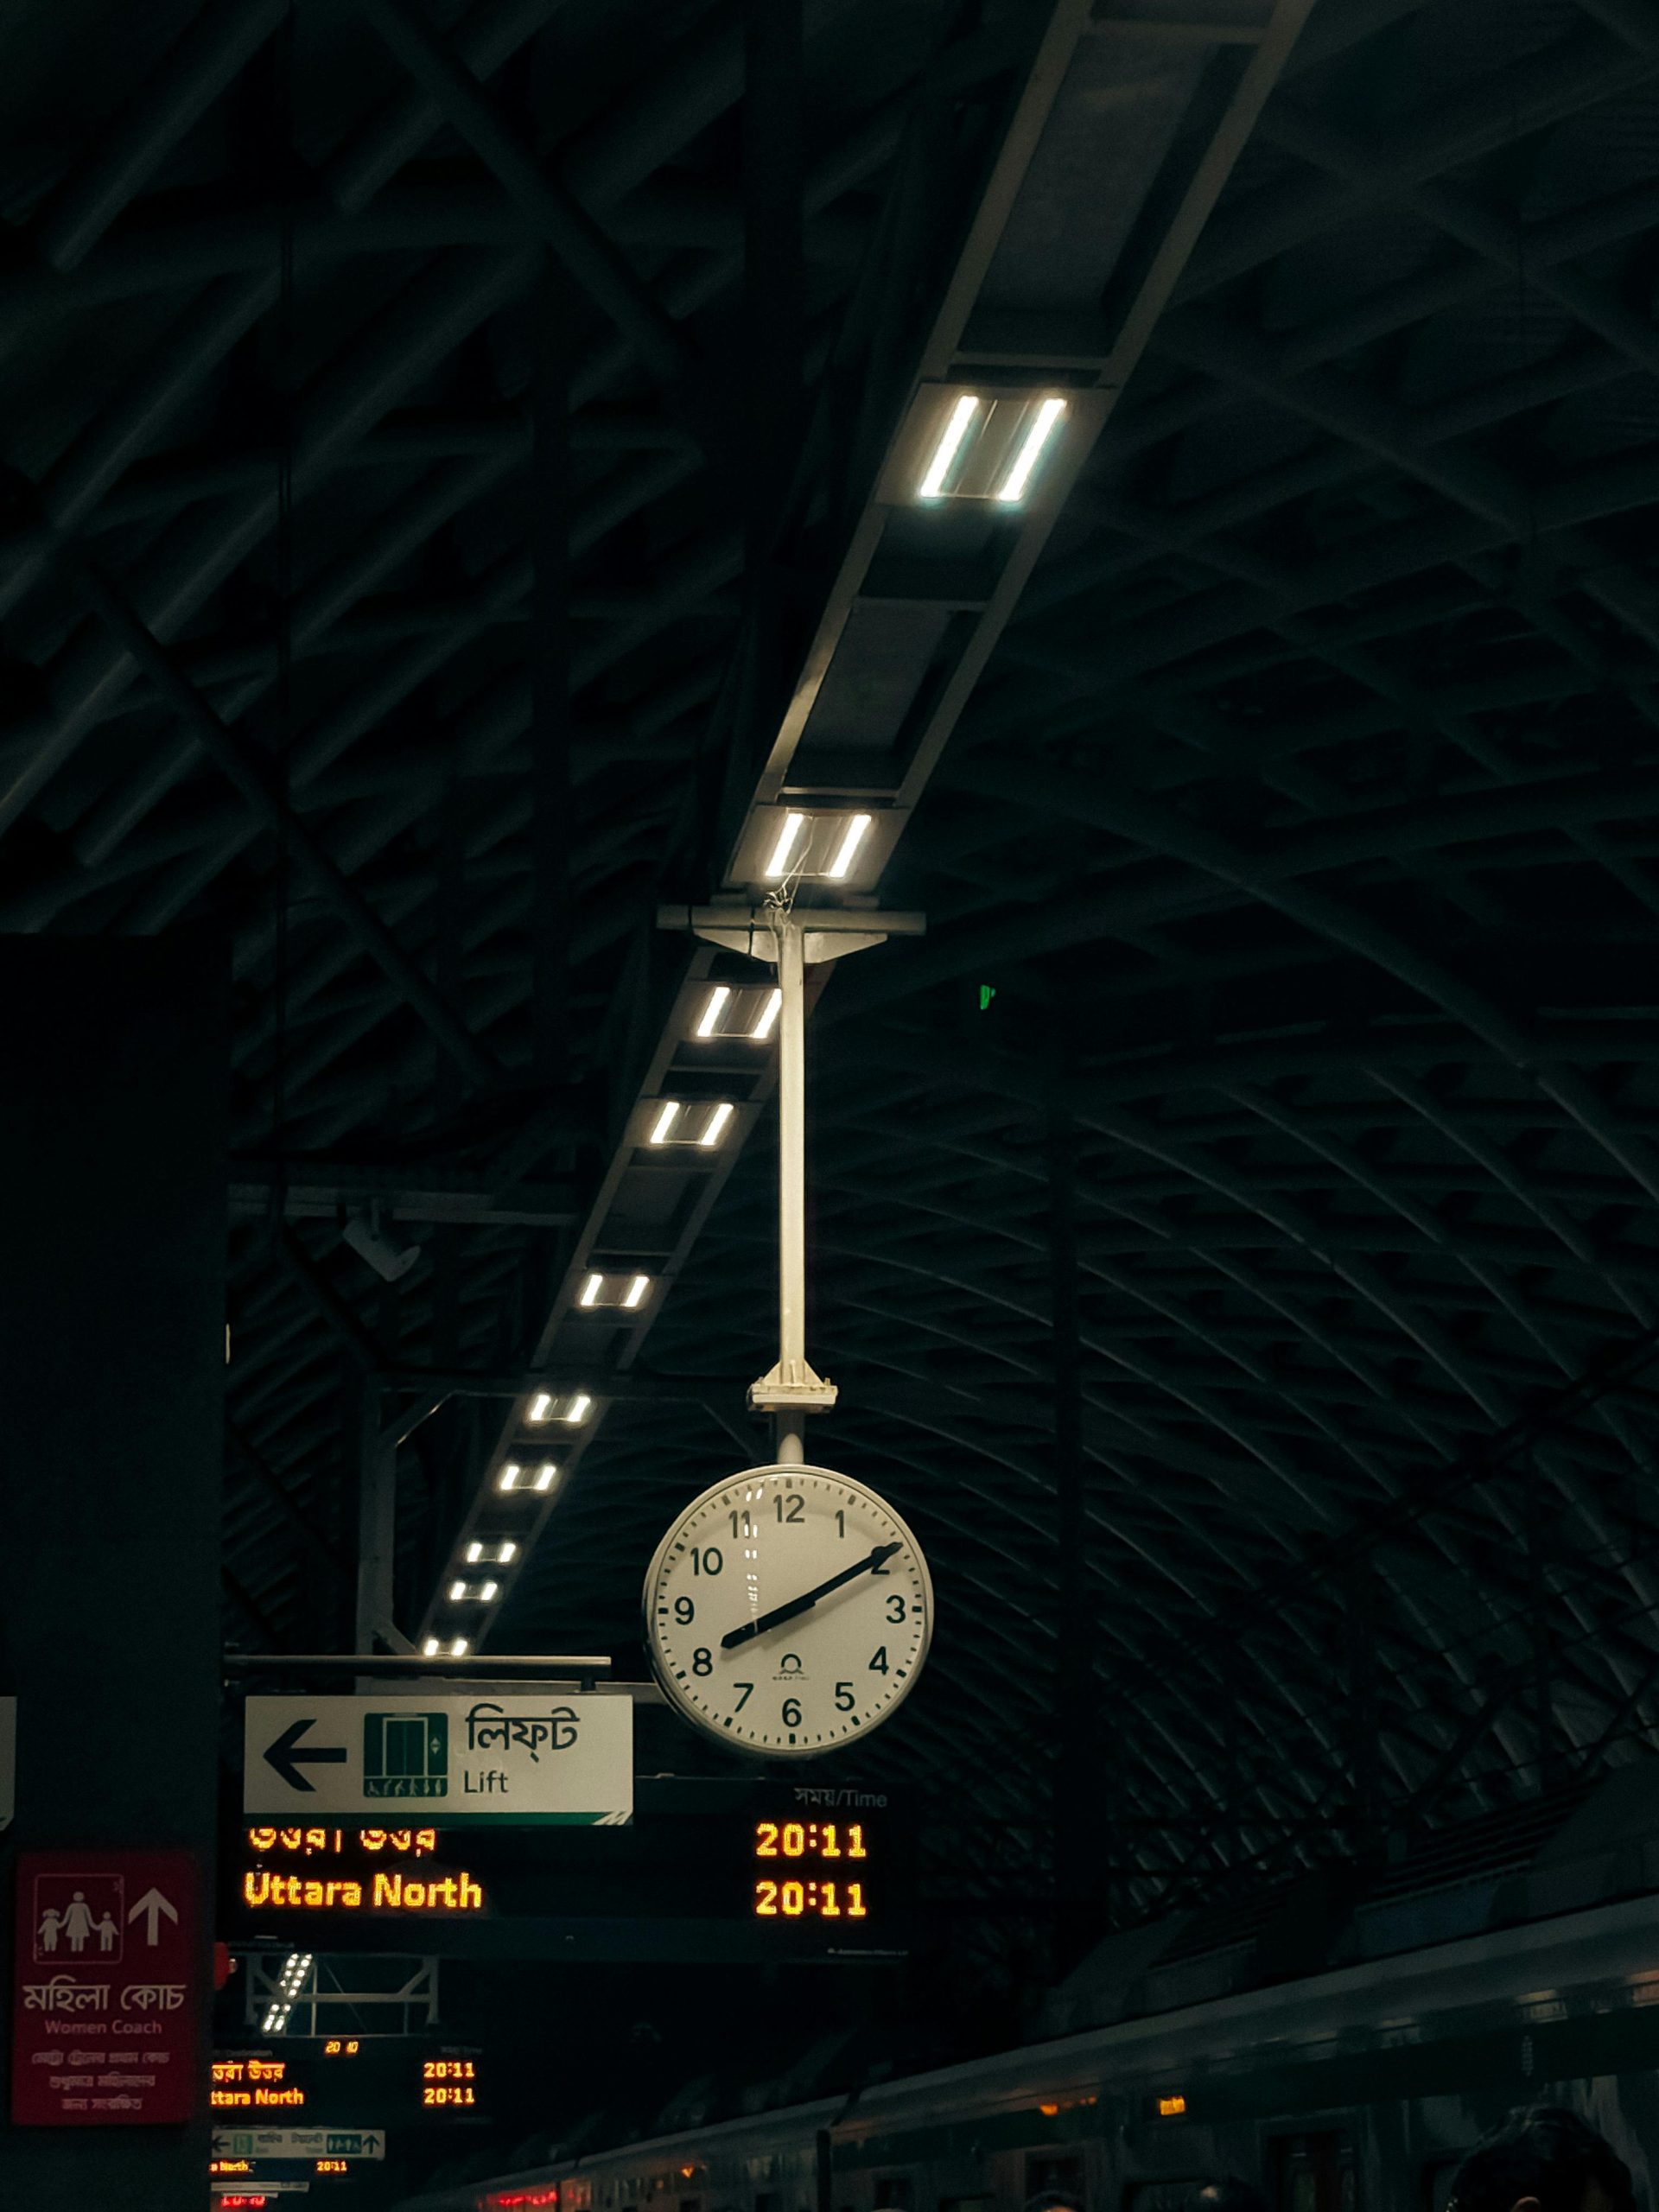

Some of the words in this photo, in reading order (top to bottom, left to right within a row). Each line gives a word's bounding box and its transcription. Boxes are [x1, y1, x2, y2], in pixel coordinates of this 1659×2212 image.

[773, 1494, 805, 1523] 12
[728, 1510, 751, 1539] 11
[835, 1510, 845, 1539] 1
[690, 1547, 723, 1576] 10
[674, 1596, 695, 1625] 9
[885, 1594, 906, 1624] 3
[692, 1647, 713, 1677] 8
[868, 1646, 889, 1675] 4
[733, 1683, 754, 1713] 7
[835, 1681, 855, 1712] 5
[781, 1698, 802, 1727] 6
[464, 1770, 508, 1794] Lift
[755, 1822, 867, 1857] 20:11
[245, 1872, 362, 1908] Uttara
[373, 1872, 482, 1909] North
[755, 1880, 867, 1916] 20:11
[22, 1975, 111, 2012] মহিলা
[120, 1985, 187, 2011] কোচ
[45, 2019, 107, 2034] Women
[111, 2018, 162, 2034] Coach
[423, 2062, 474, 2078] 20:11
[256, 2088, 304, 2105] North
[423, 2088, 474, 2104] 20:11
[316, 2161, 347, 2171] 20:11
